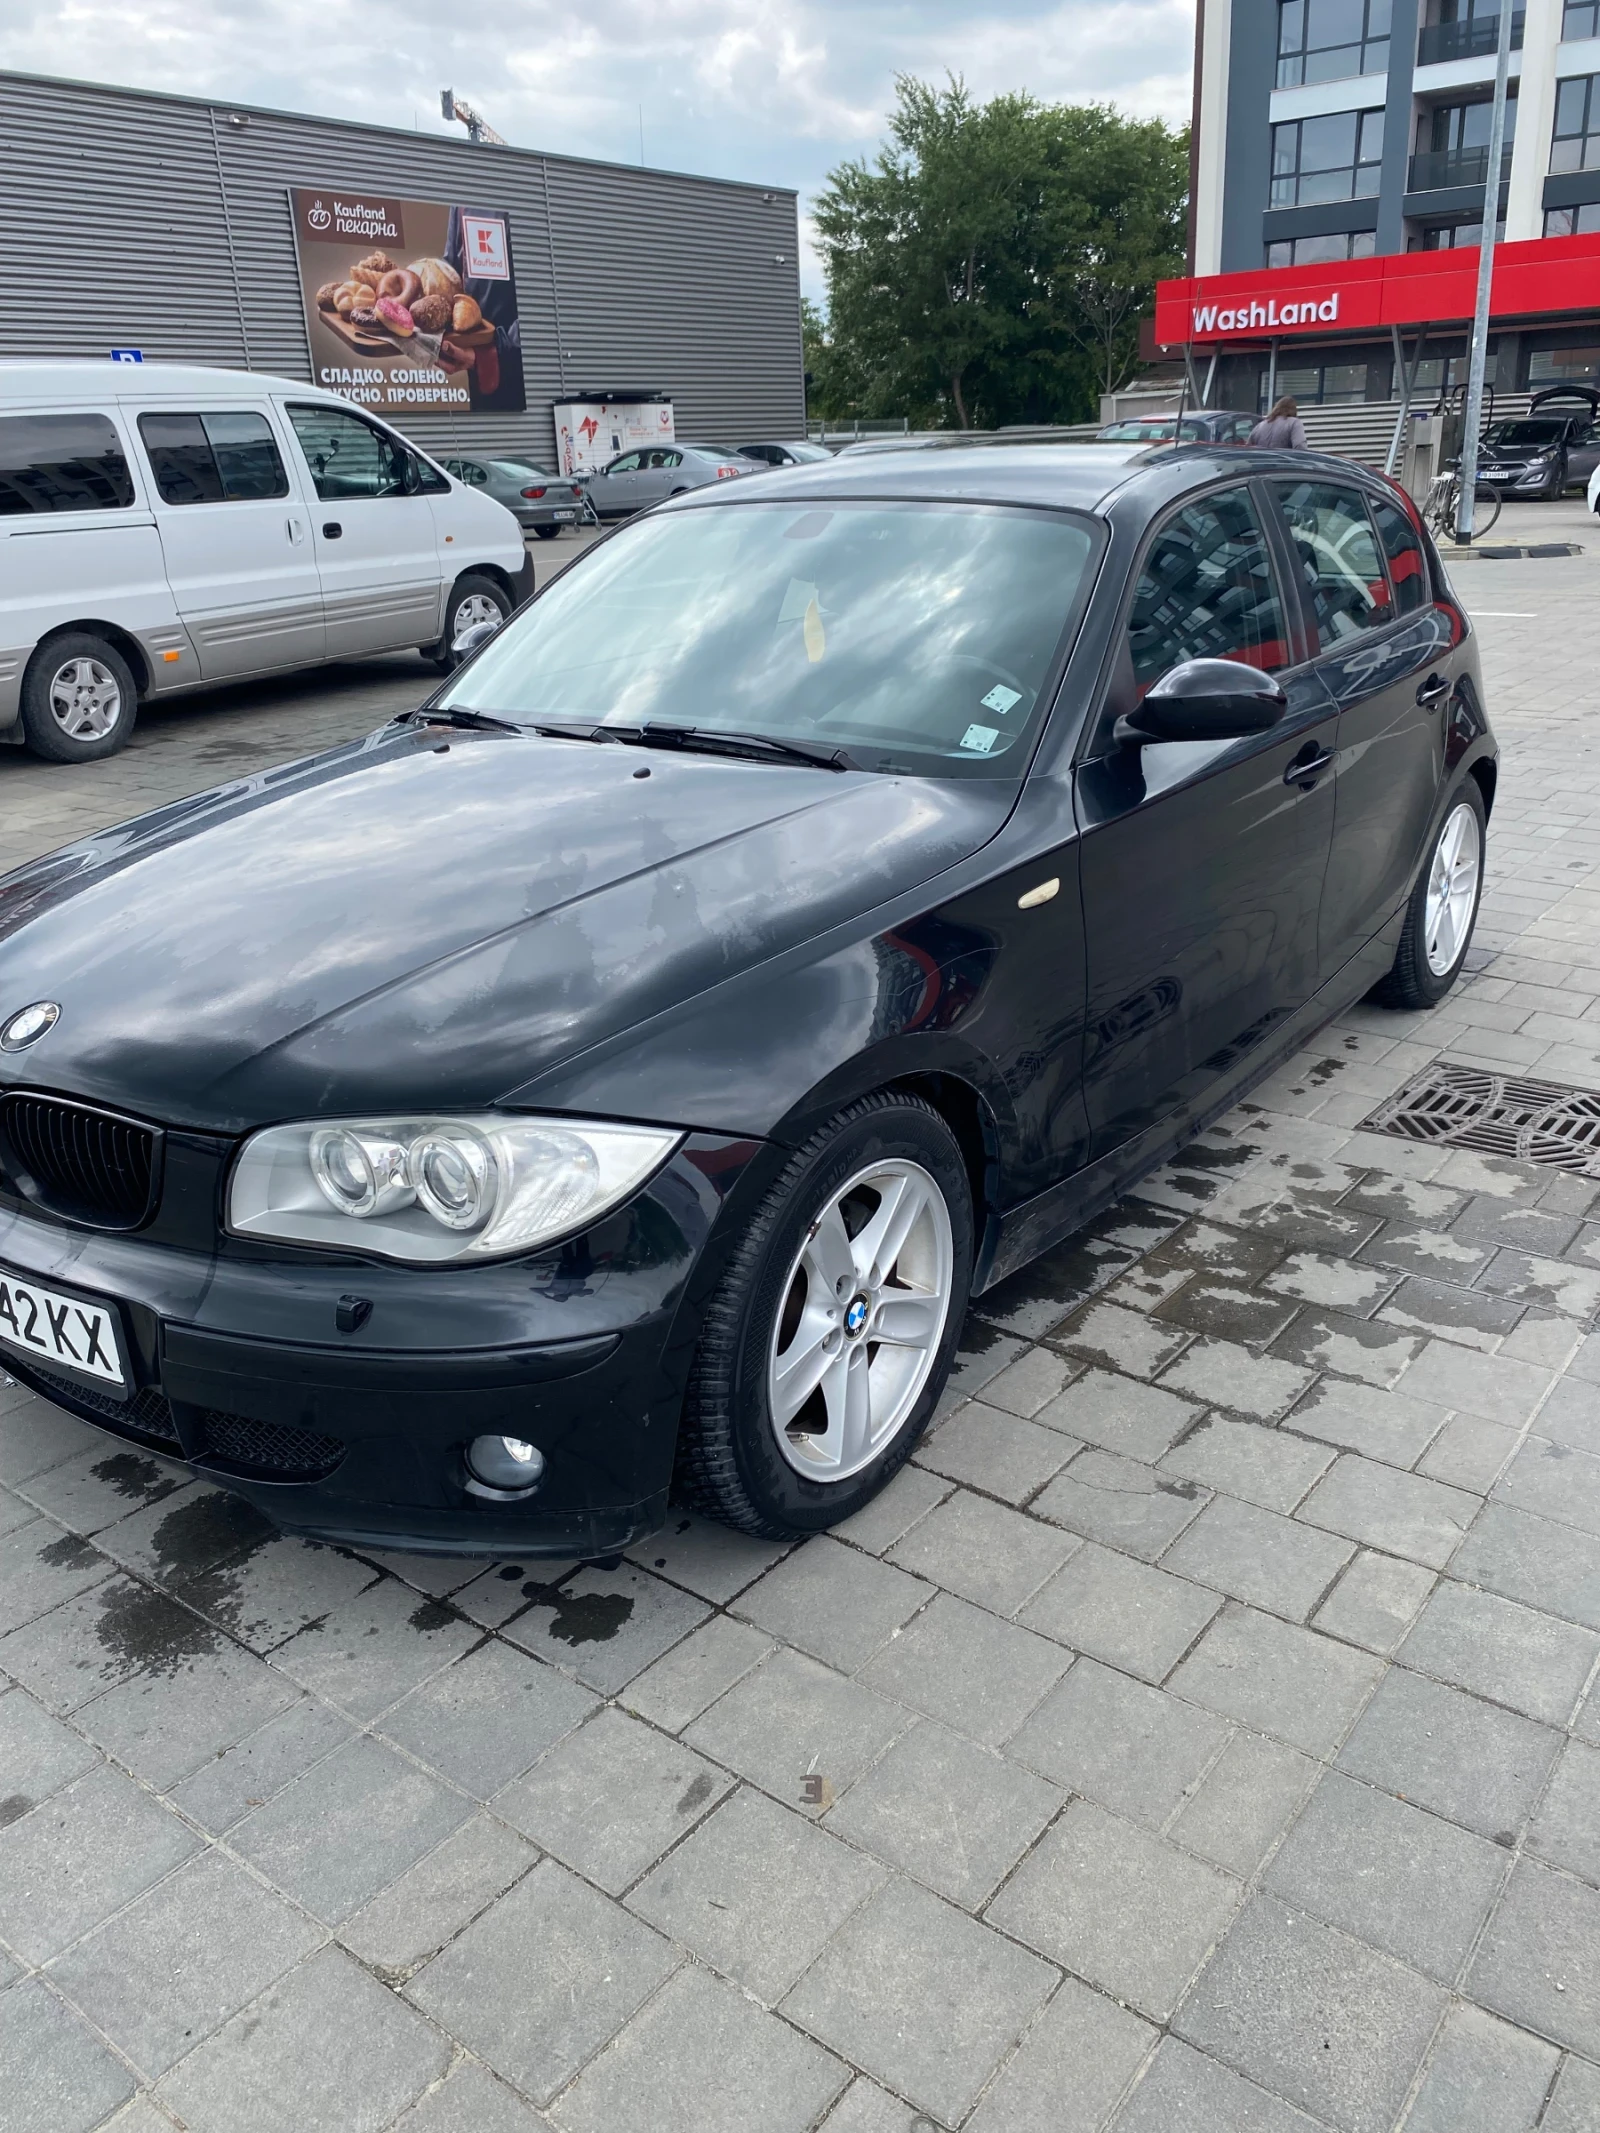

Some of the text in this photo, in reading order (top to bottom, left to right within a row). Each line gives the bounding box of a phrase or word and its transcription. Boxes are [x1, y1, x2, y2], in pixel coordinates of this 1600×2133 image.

[333, 202, 386, 220] Kaufland
[336, 218, 398, 238] пекарна
[472, 257, 502, 267] Kaufland
[1193, 292, 1339, 332] WashLand
[320, 368, 449, 385] СЛАДКО. СОЛЕНО.
[323, 387, 471, 403] КУСНО. ПРОВЕРЕНО.
[0, 1281, 114, 1372] 42KX
